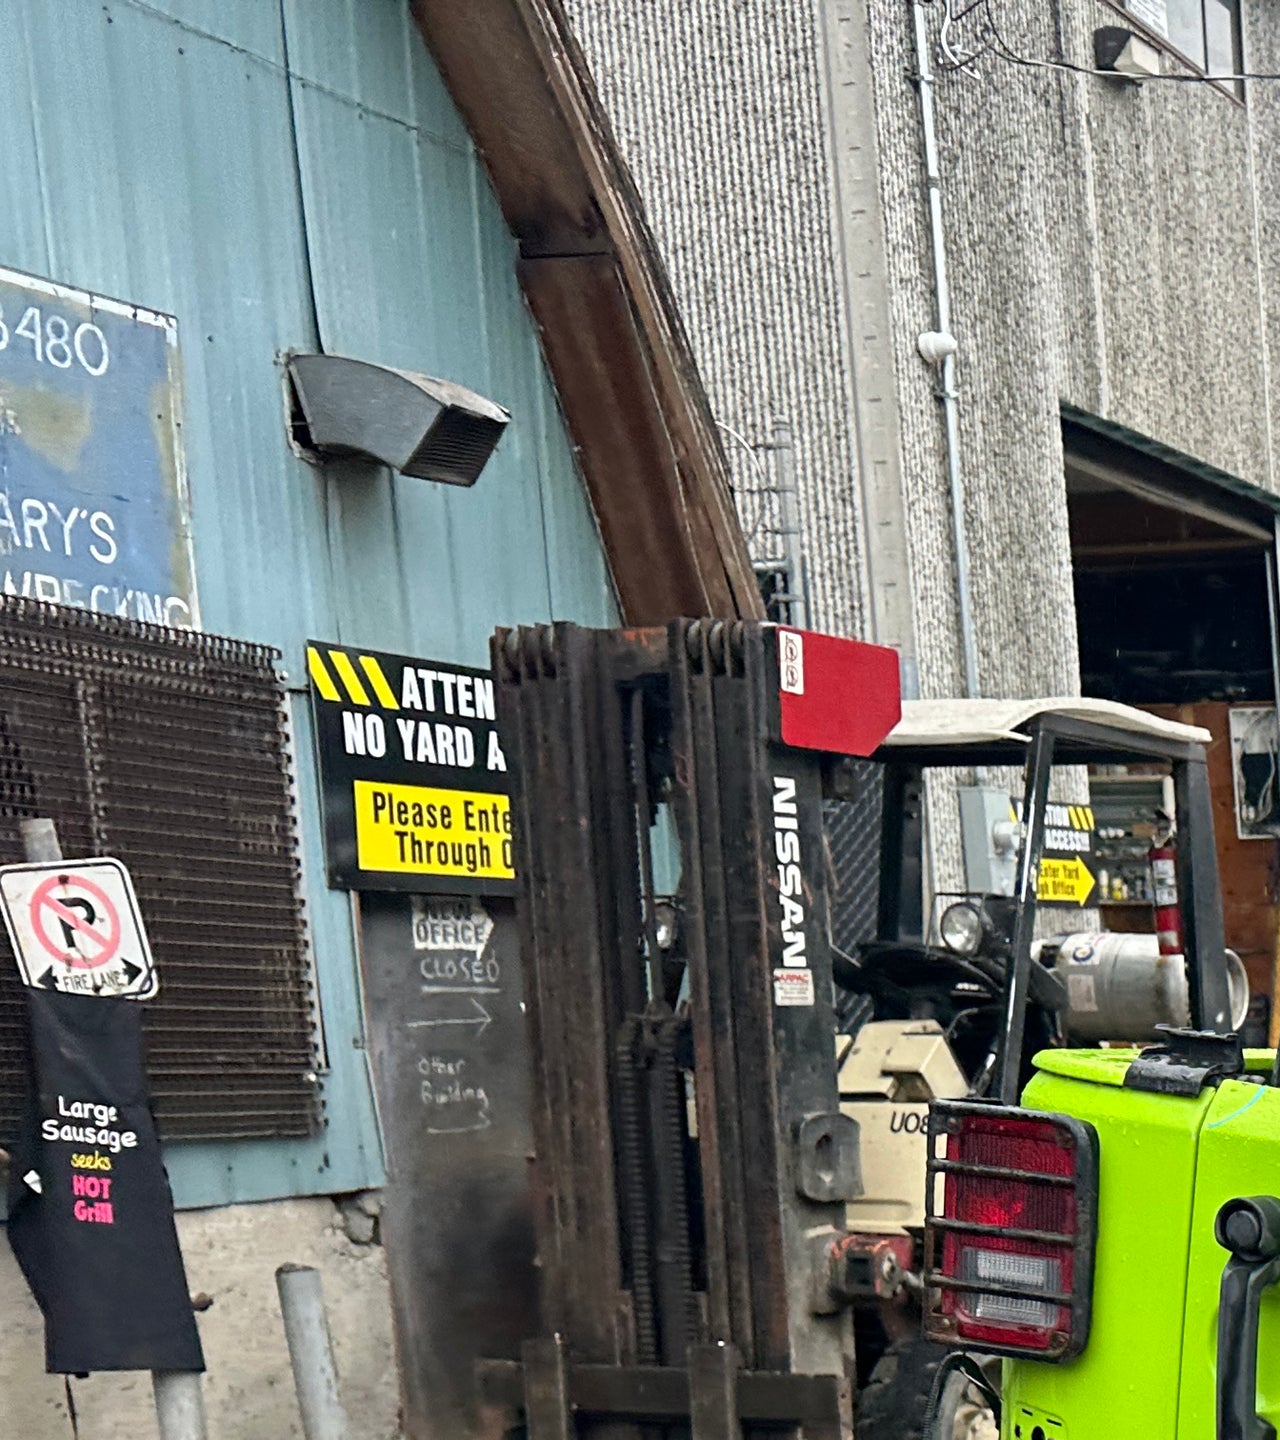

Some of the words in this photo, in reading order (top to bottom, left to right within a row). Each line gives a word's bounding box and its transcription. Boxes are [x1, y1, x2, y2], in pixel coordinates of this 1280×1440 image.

[342, 711, 387, 758] NO
[396, 718, 475, 768] YARD
[372, 791, 453, 830] Please
[394, 830, 492, 873] Through
[773, 776, 808, 968] NISSAN
[416, 919, 486, 945] OFFICE
[62, 974, 92, 991] FIRE
[58, 1095, 118, 1127] Large
[42, 1119, 138, 1153] Sausage
[71, 1150, 112, 1171] seeks
[73, 1174, 111, 1199] HOT
[74, 1200, 114, 1224] Grill
